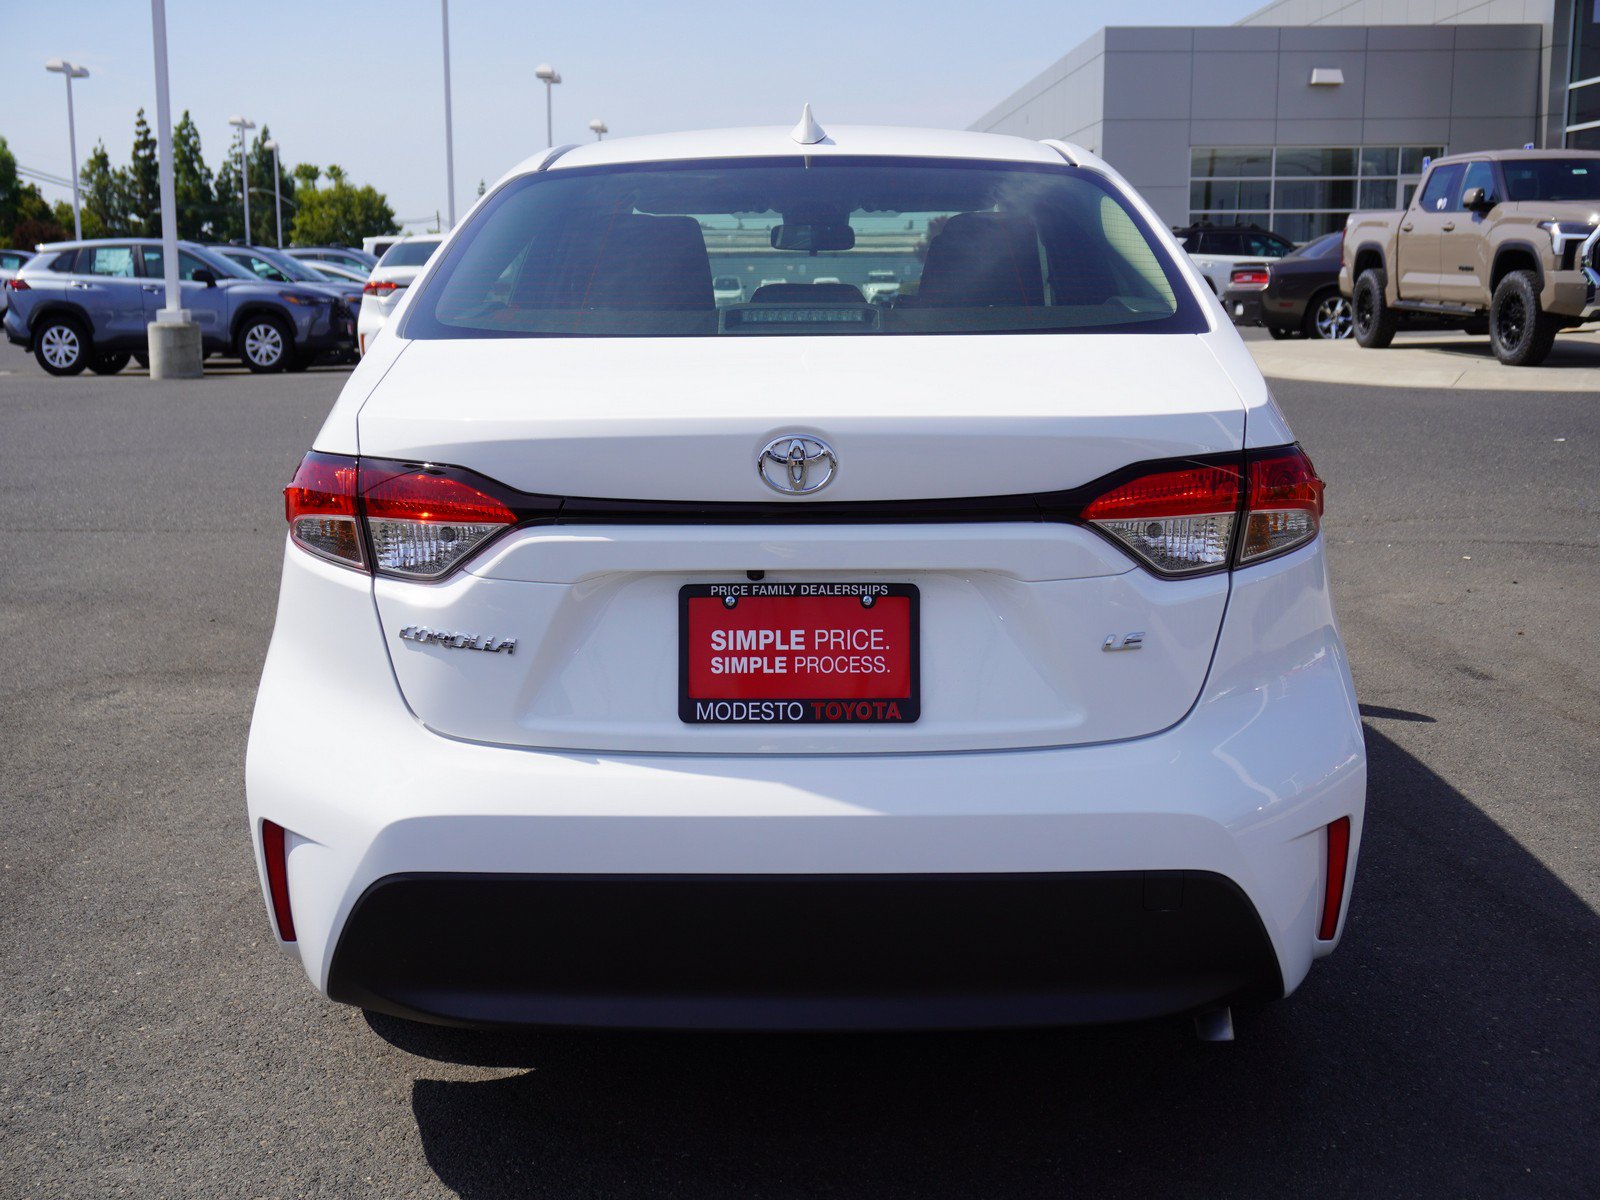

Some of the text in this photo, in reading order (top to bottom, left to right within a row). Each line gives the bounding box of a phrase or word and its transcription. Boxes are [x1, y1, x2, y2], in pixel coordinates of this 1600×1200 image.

[710, 585, 888, 596] PRICE FAMILY DEALERSHIPS
[399, 624, 518, 655] COROLLA
[710, 629, 890, 651] SIMPLE PRICE.
[1102, 632, 1145, 652] LE
[710, 656, 891, 674] SIMPLE PROCESS.
[696, 702, 901, 721] MODESTO TOYOTA
